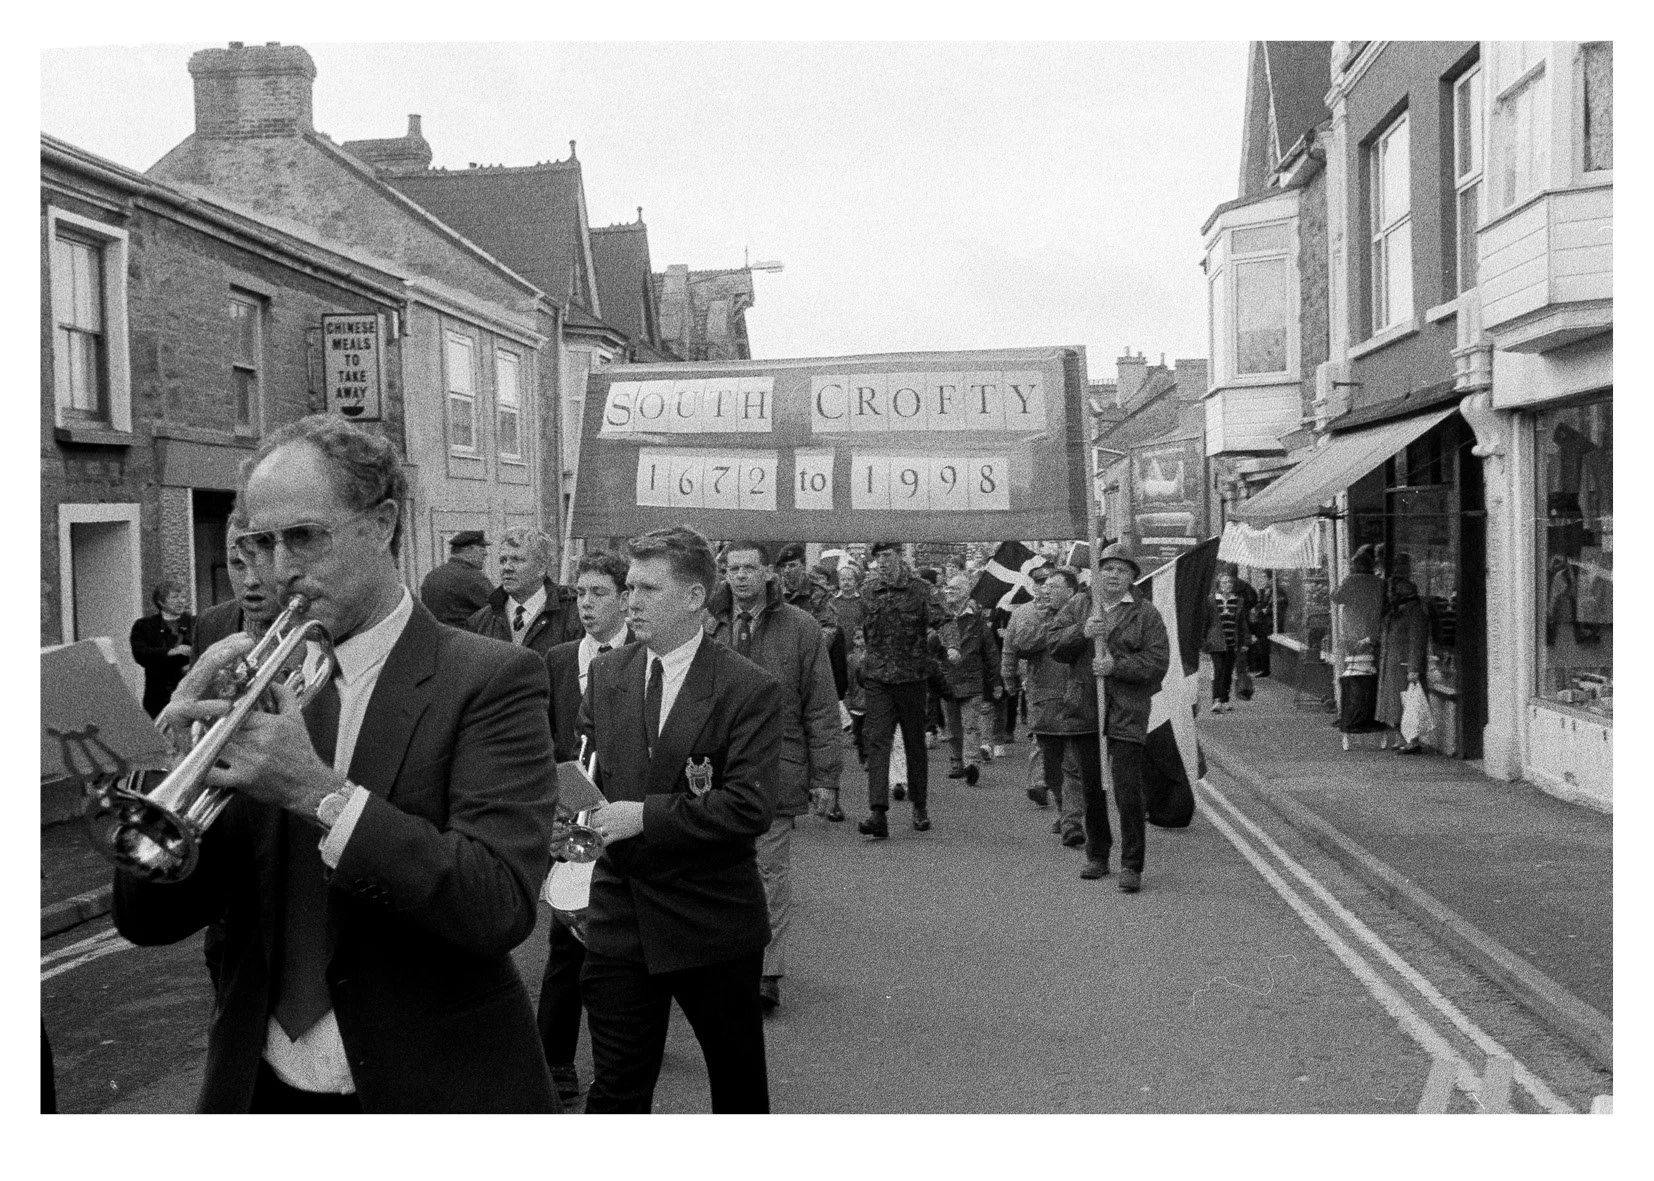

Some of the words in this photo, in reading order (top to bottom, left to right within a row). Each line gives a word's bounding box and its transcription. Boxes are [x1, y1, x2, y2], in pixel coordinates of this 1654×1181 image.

[326, 322, 375, 334] CHINESE
[332, 338, 371, 350] MEALS
[344, 354, 360, 366] TO
[338, 370, 366, 382] TAKE
[336, 386, 367, 399] AWAY
[605, 389, 767, 426] SOUTH
[816, 384, 1038, 420] CROFTY
[648, 463, 766, 496] 1672
[799, 466, 827, 493] to
[865, 464, 997, 497] 1998
